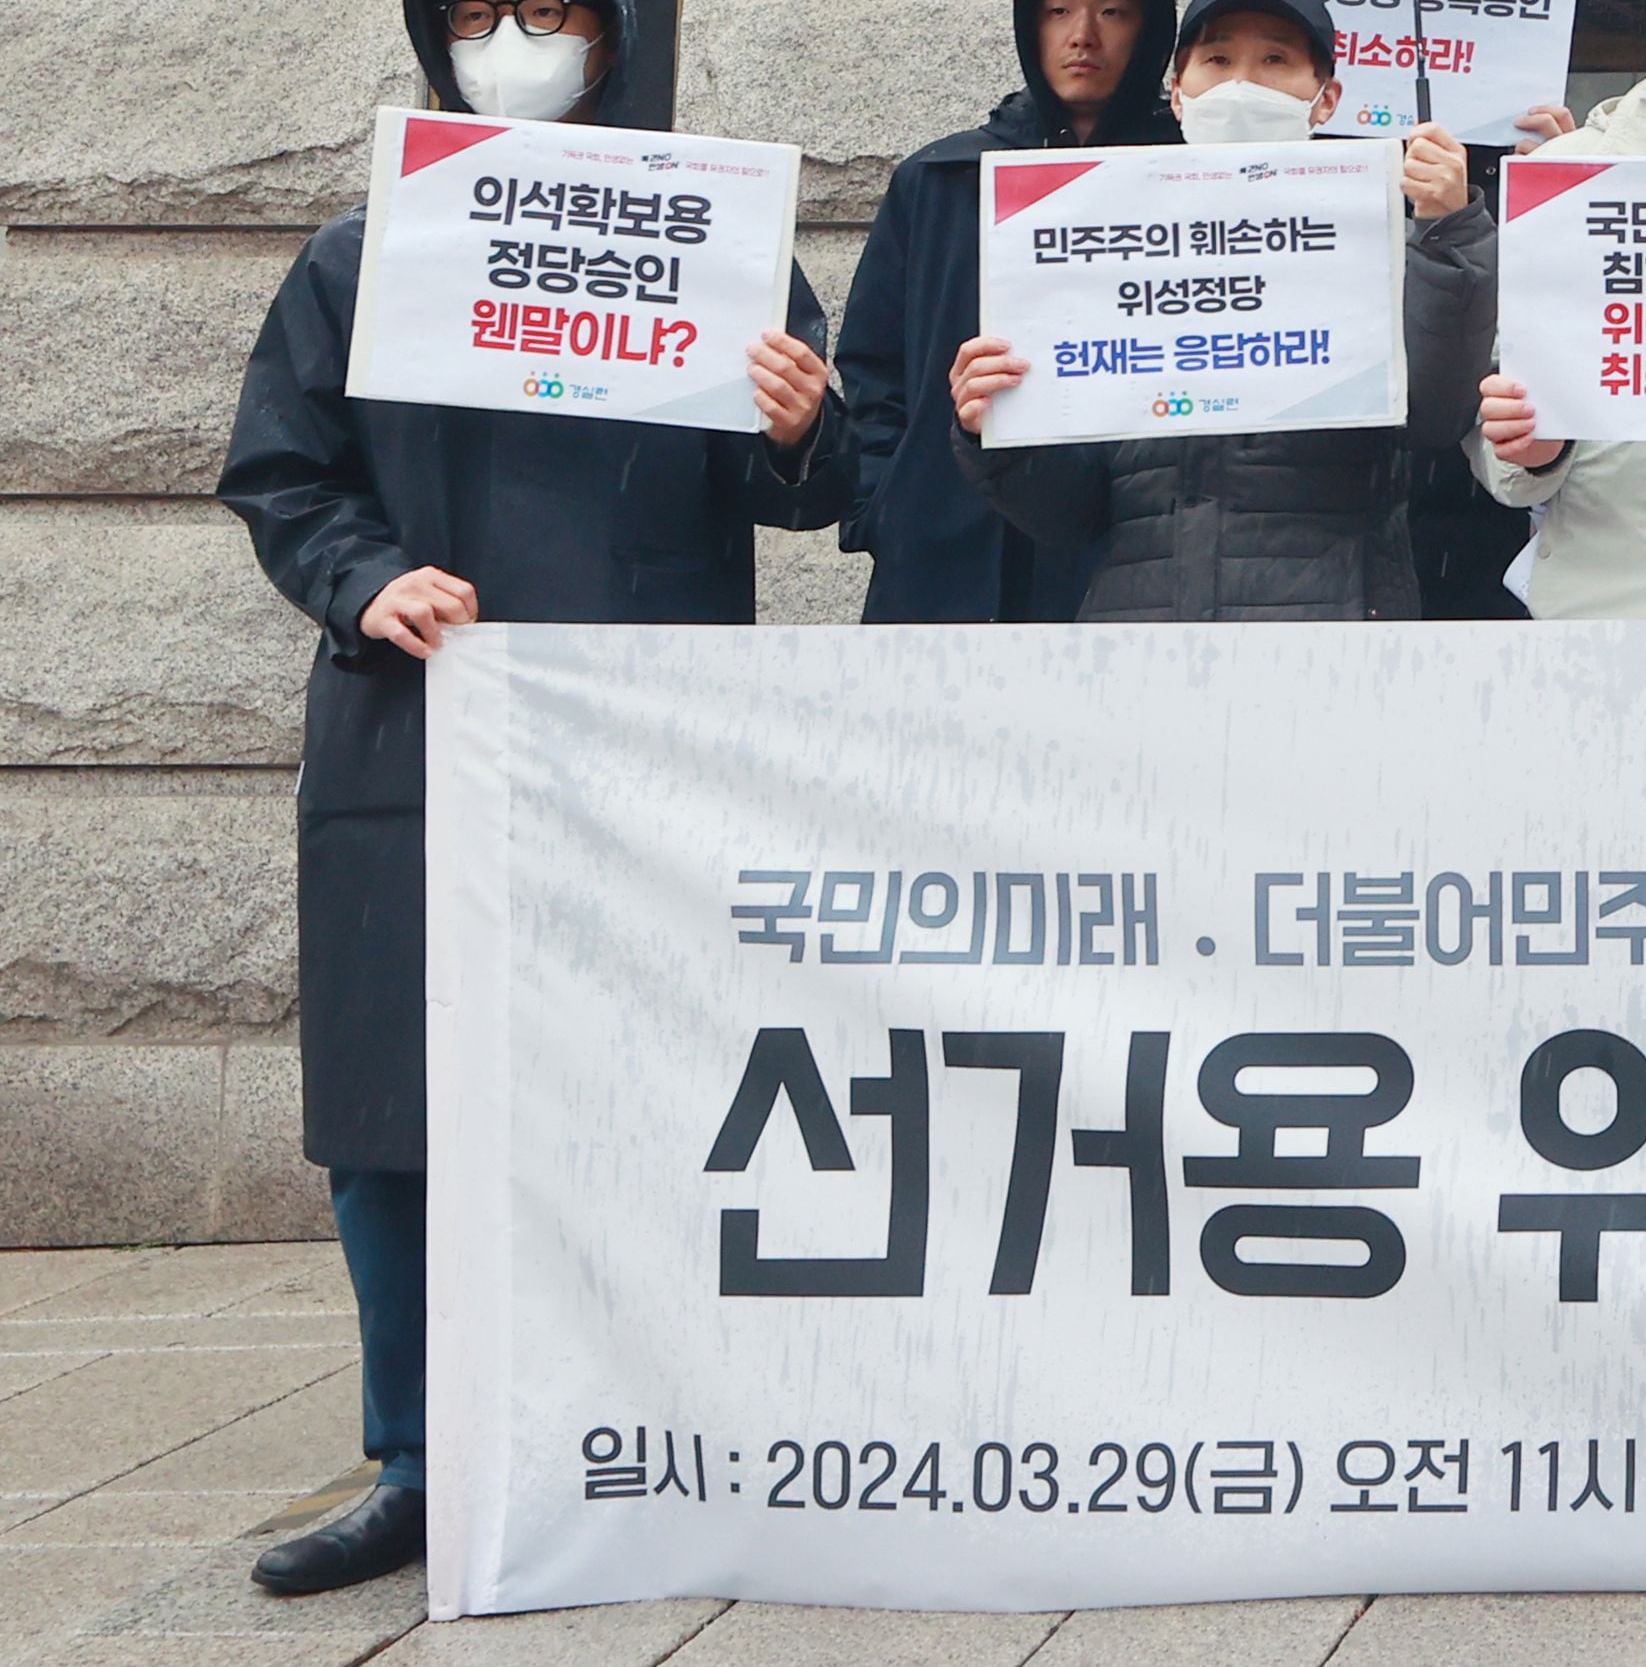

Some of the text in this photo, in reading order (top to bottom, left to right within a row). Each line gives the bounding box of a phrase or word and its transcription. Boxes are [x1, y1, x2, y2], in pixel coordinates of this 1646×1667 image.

[1334, 30, 1475, 73] 취소하라!
[469, 175, 712, 245] 의석확보용
[1033, 215, 1337, 265] 민주주의 훼손하는
[487, 239, 681, 305] 정당승인
[1117, 274, 1266, 317] 위성정당
[471, 299, 698, 368] 웬말이냐?
[1053, 329, 1330, 378] 헌재는 응답하라!
[730, 870, 1159, 966] 국민의미래
[702, 1027, 1422, 1300] 선거용
[767, 1439, 1304, 1515] 2024.03.29(금)
[1330, 1438, 1470, 1513] 오전
[1501, 1438, 1636, 1513] 11시
